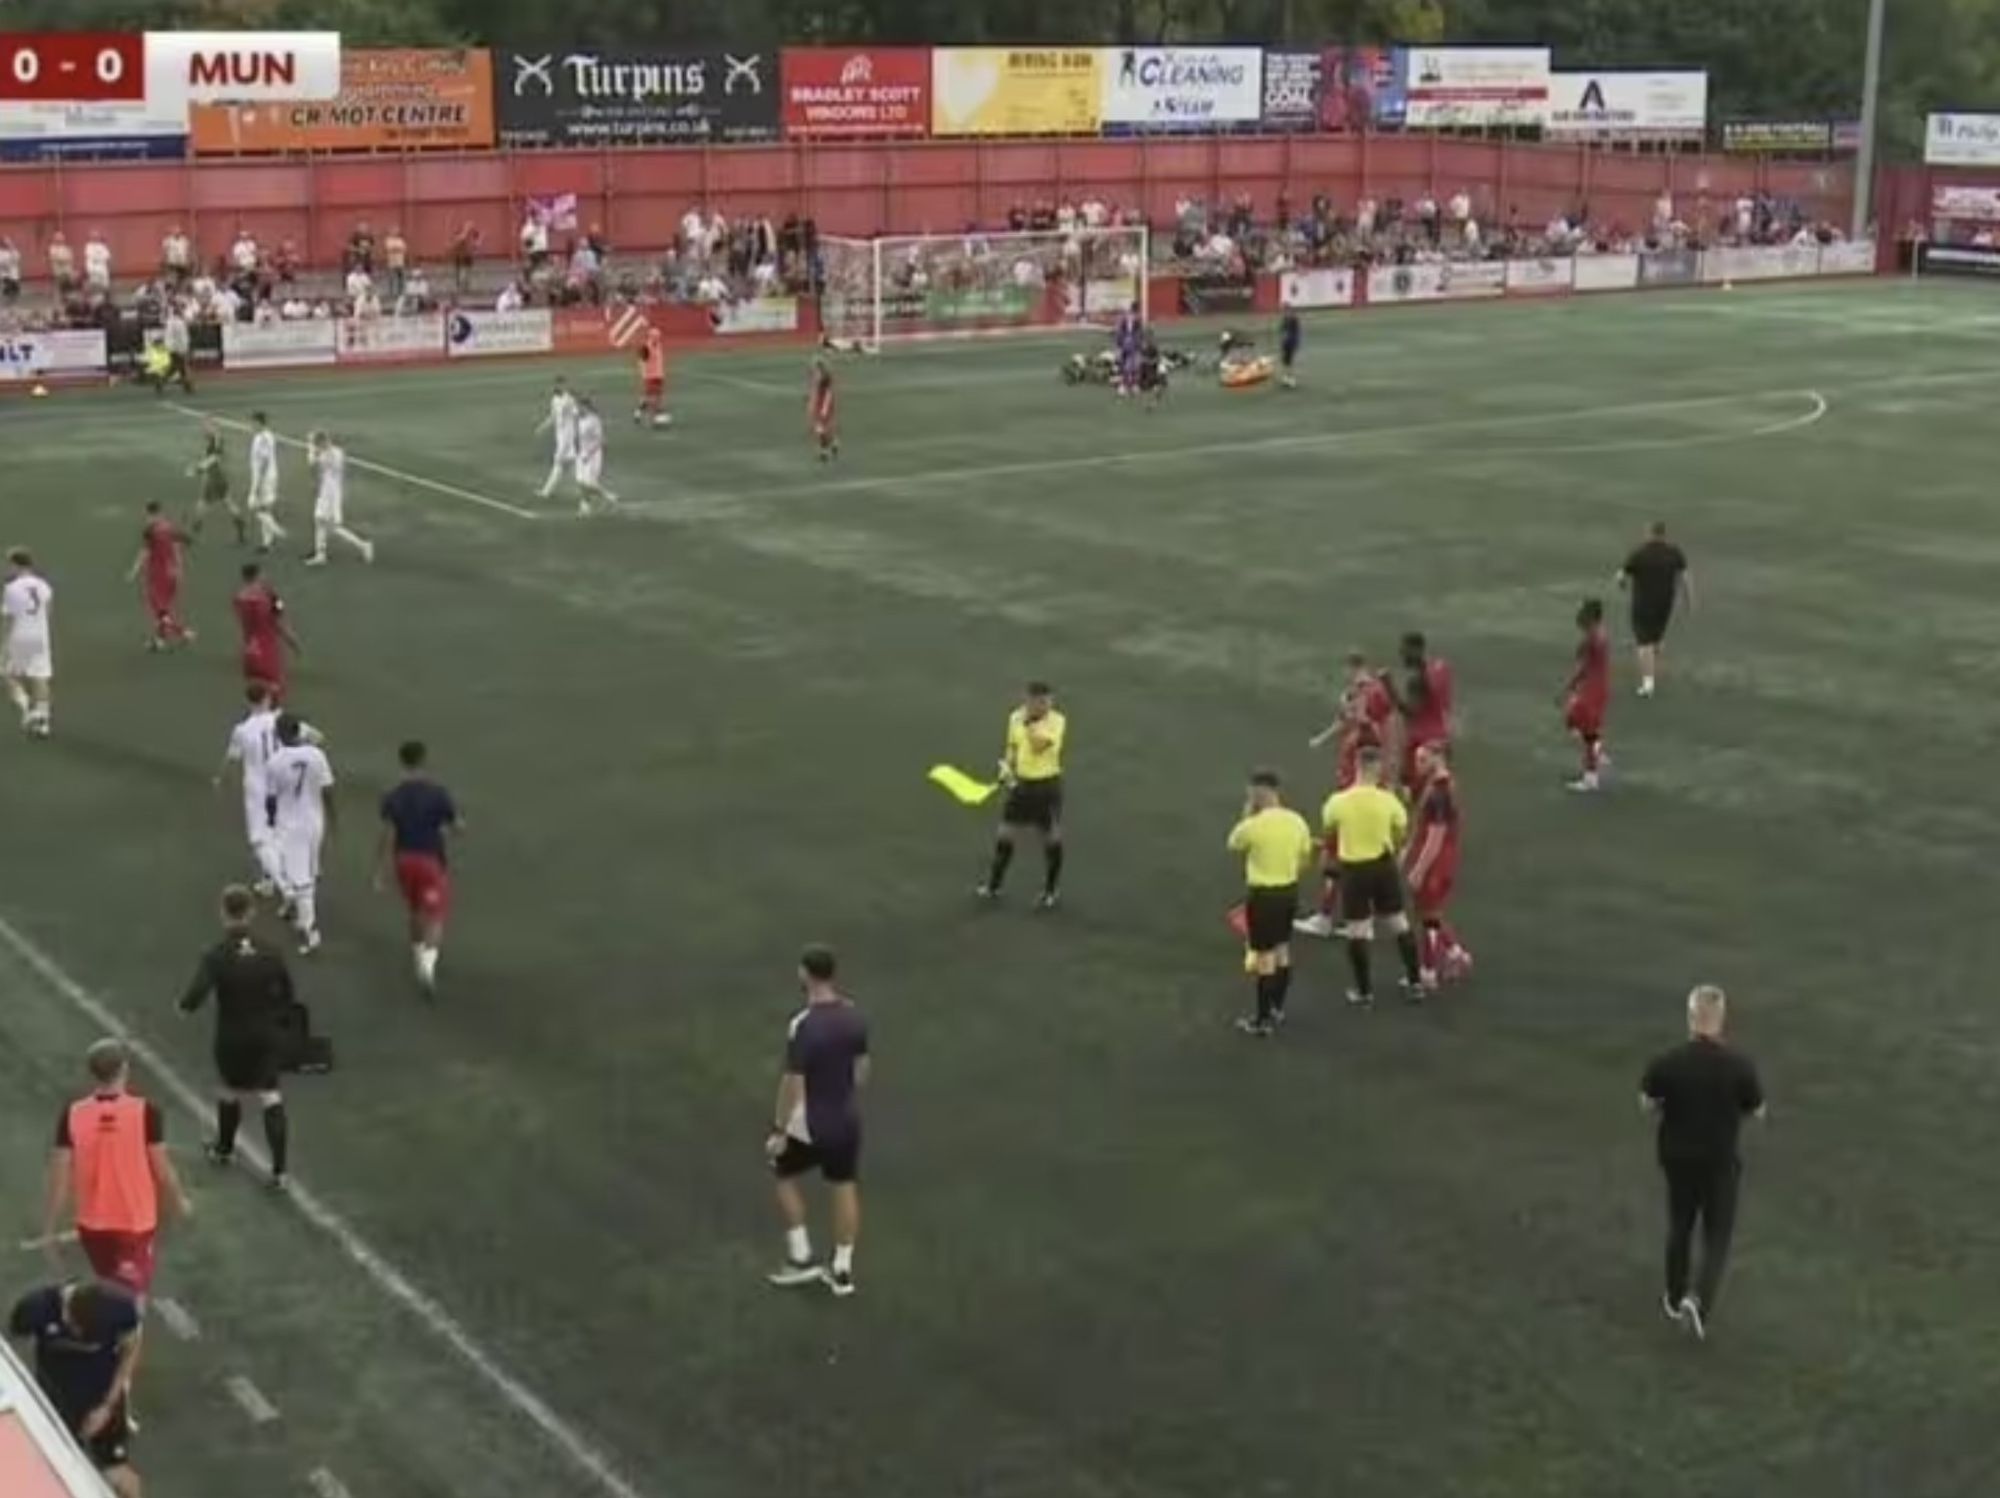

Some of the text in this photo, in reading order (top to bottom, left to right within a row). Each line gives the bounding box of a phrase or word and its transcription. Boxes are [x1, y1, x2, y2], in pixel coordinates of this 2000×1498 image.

[562, 54, 705, 101] Turpins
[1139, 56, 1244, 87] CLEANING
[869, 87, 921, 102] SCOTT
[329, 106, 376, 127] MOT
[380, 105, 467, 126] CENTRE
[291, 760, 308, 799] 7
